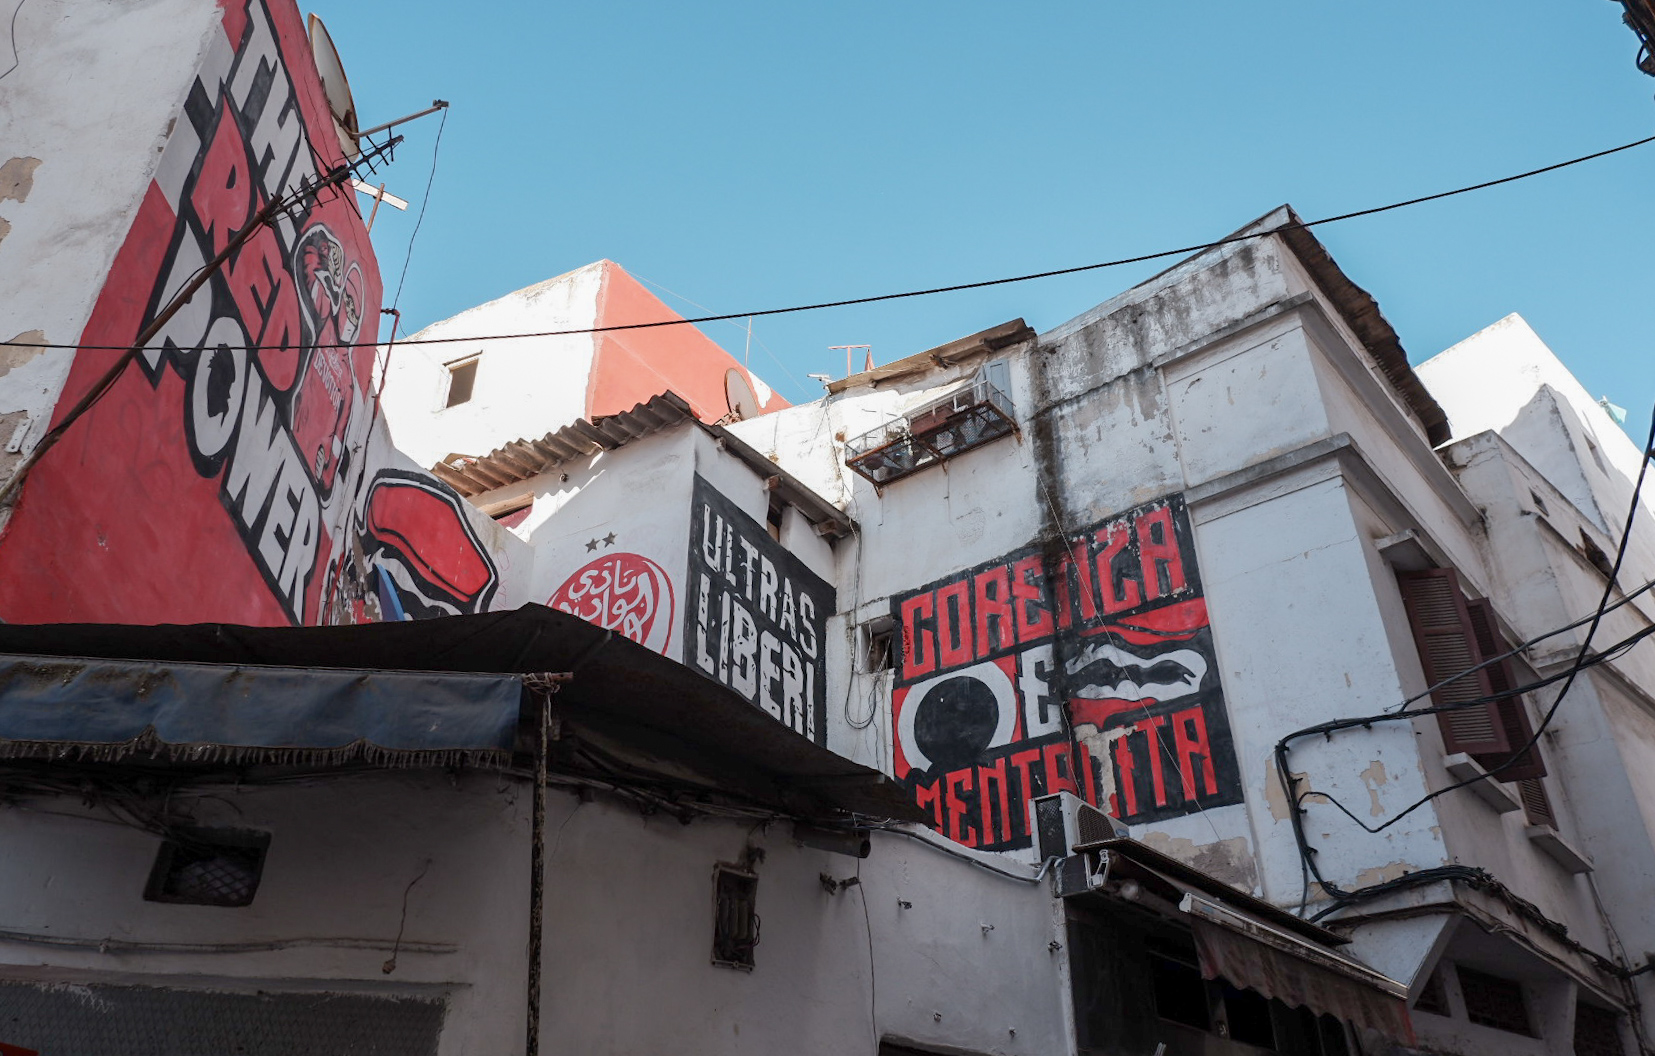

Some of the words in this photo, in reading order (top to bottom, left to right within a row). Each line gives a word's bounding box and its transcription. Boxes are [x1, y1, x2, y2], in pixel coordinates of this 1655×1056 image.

[190, 93, 302, 392] RED
[231, 0, 316, 250] THE
[137, 218, 320, 626] POWER
[696, 574, 815, 742] LIBERI
[702, 503, 818, 660] ULTRAS
